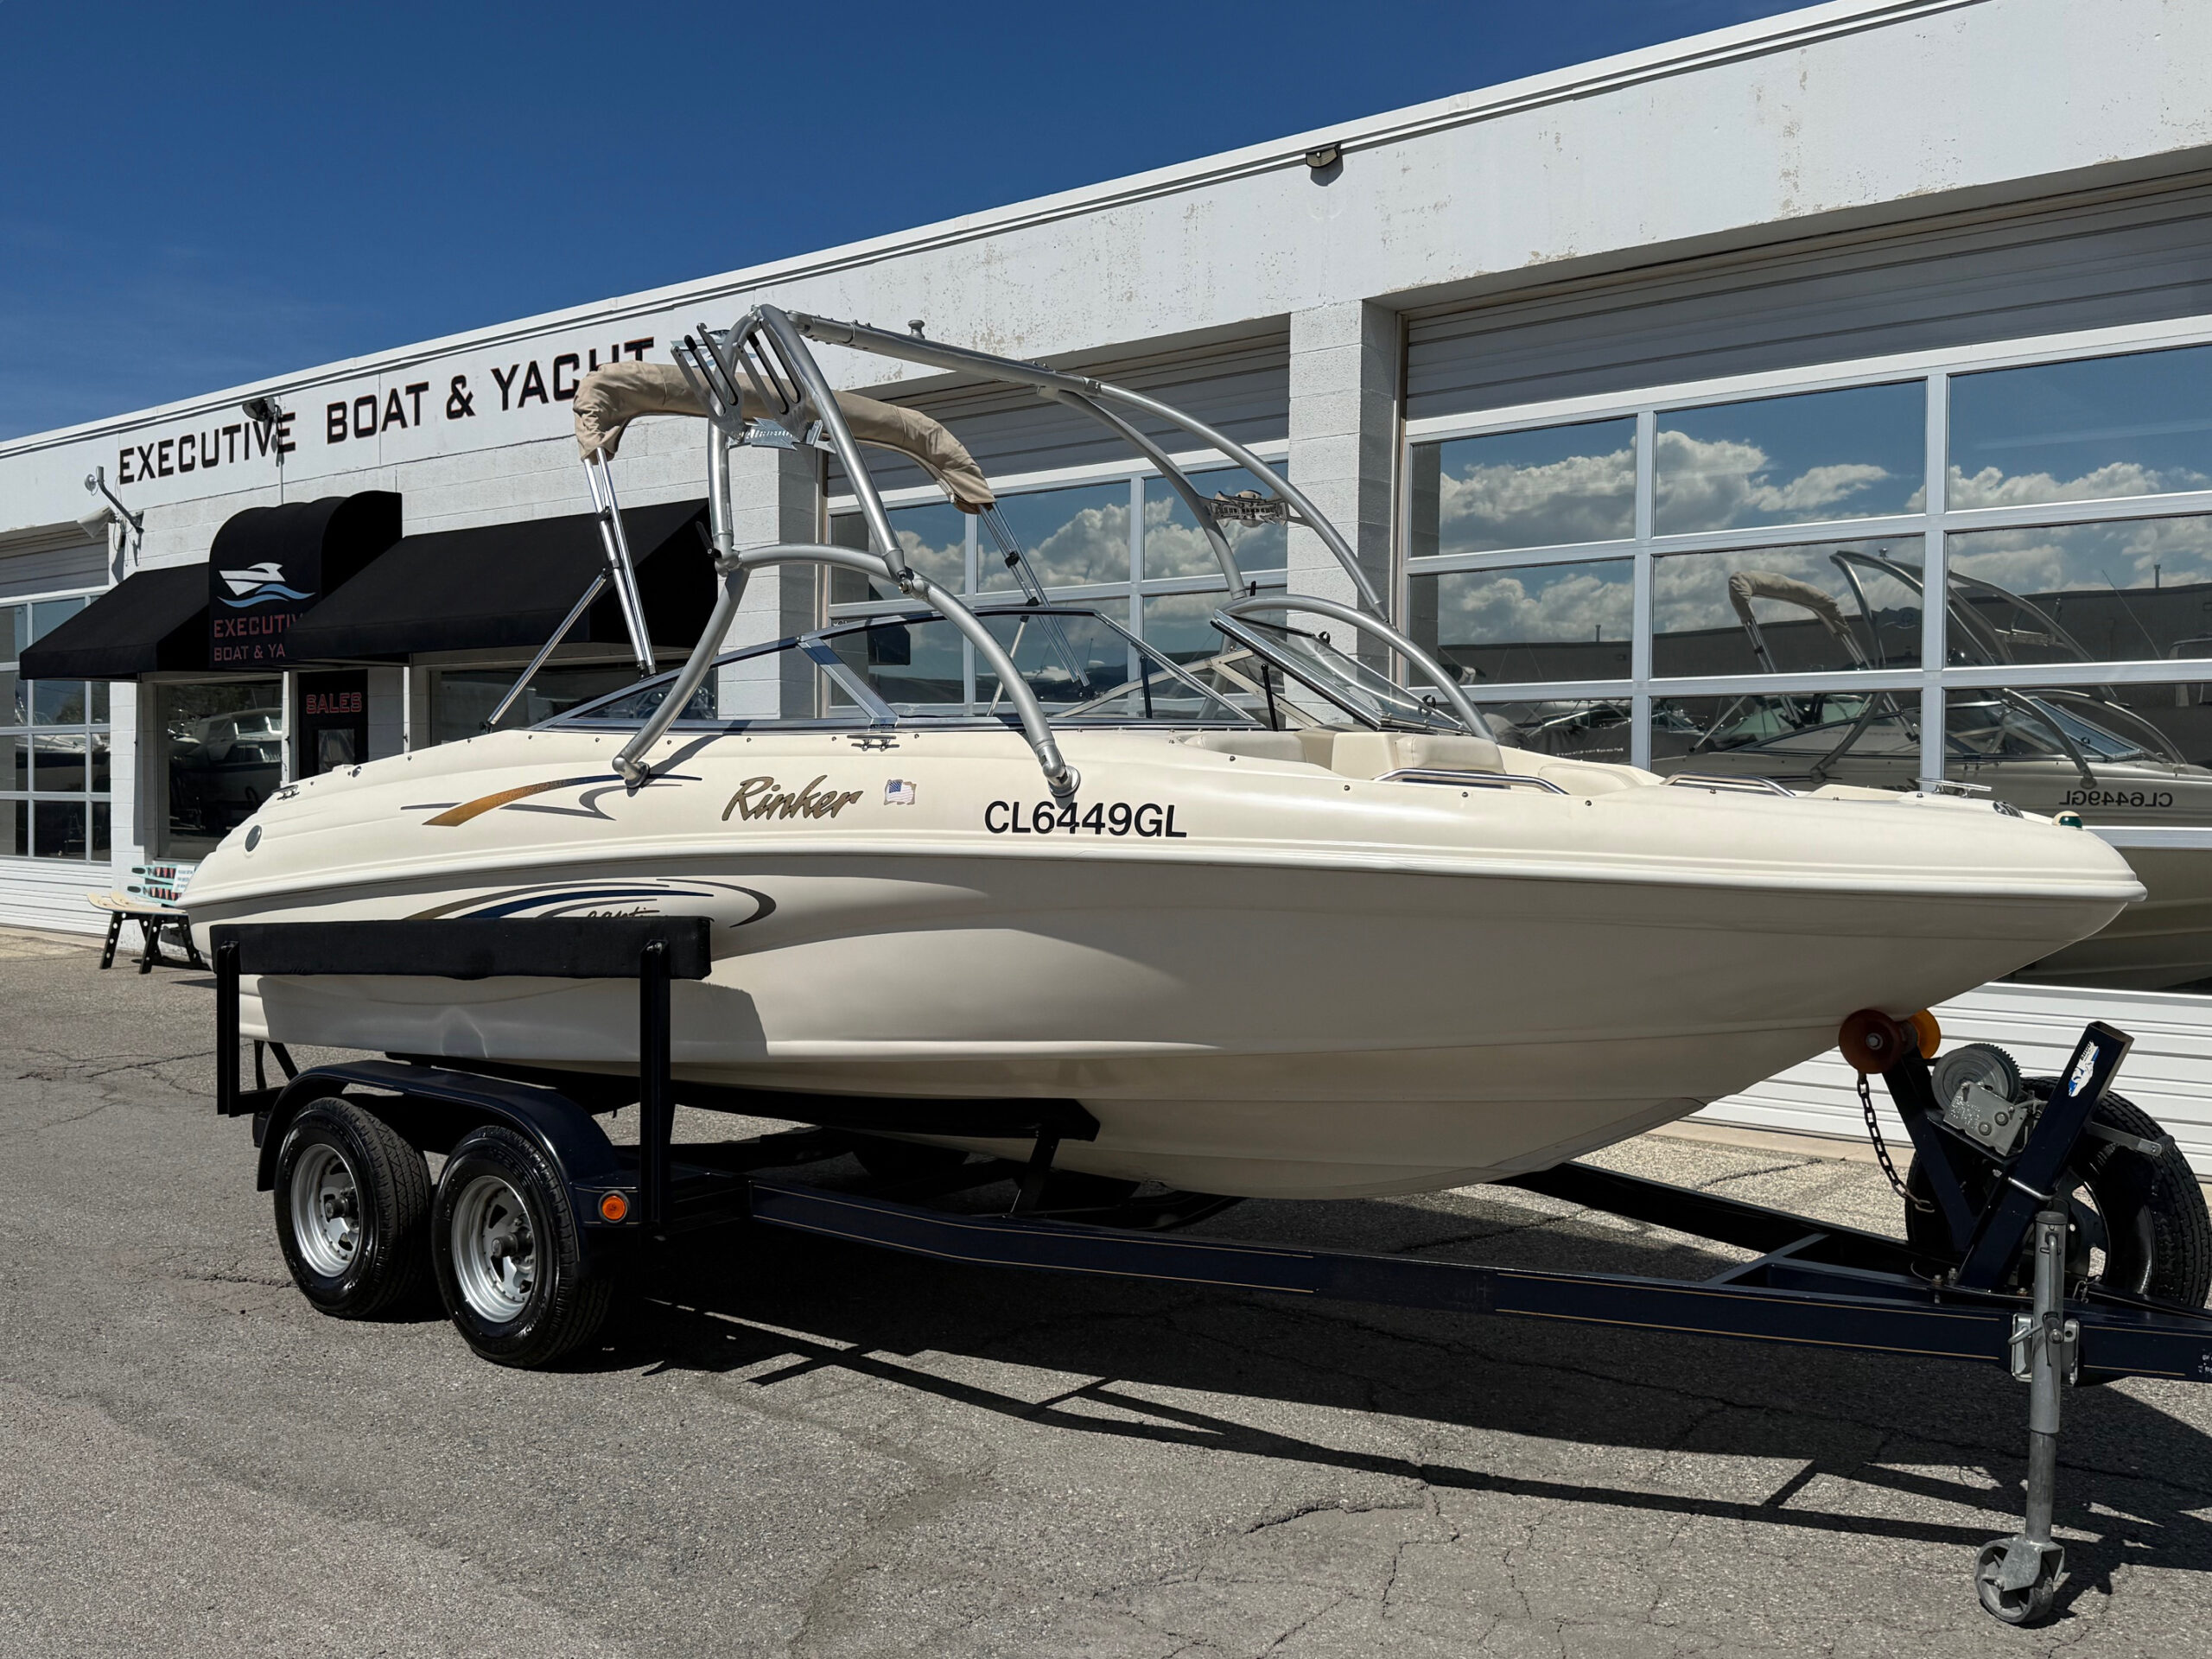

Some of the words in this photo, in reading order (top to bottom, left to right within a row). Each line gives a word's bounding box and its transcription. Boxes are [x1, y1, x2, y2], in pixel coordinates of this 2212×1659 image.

[119, 411, 296, 486] EXECUTIVE
[327, 381, 429, 445] BOAT
[446, 374, 476, 420] &
[213, 645, 249, 662] BOAT
[254, 645, 264, 659] &
[306, 692, 362, 715] SALES
[721, 774, 864, 821] Rinker
[984, 800, 1187, 838] CL6449GL
